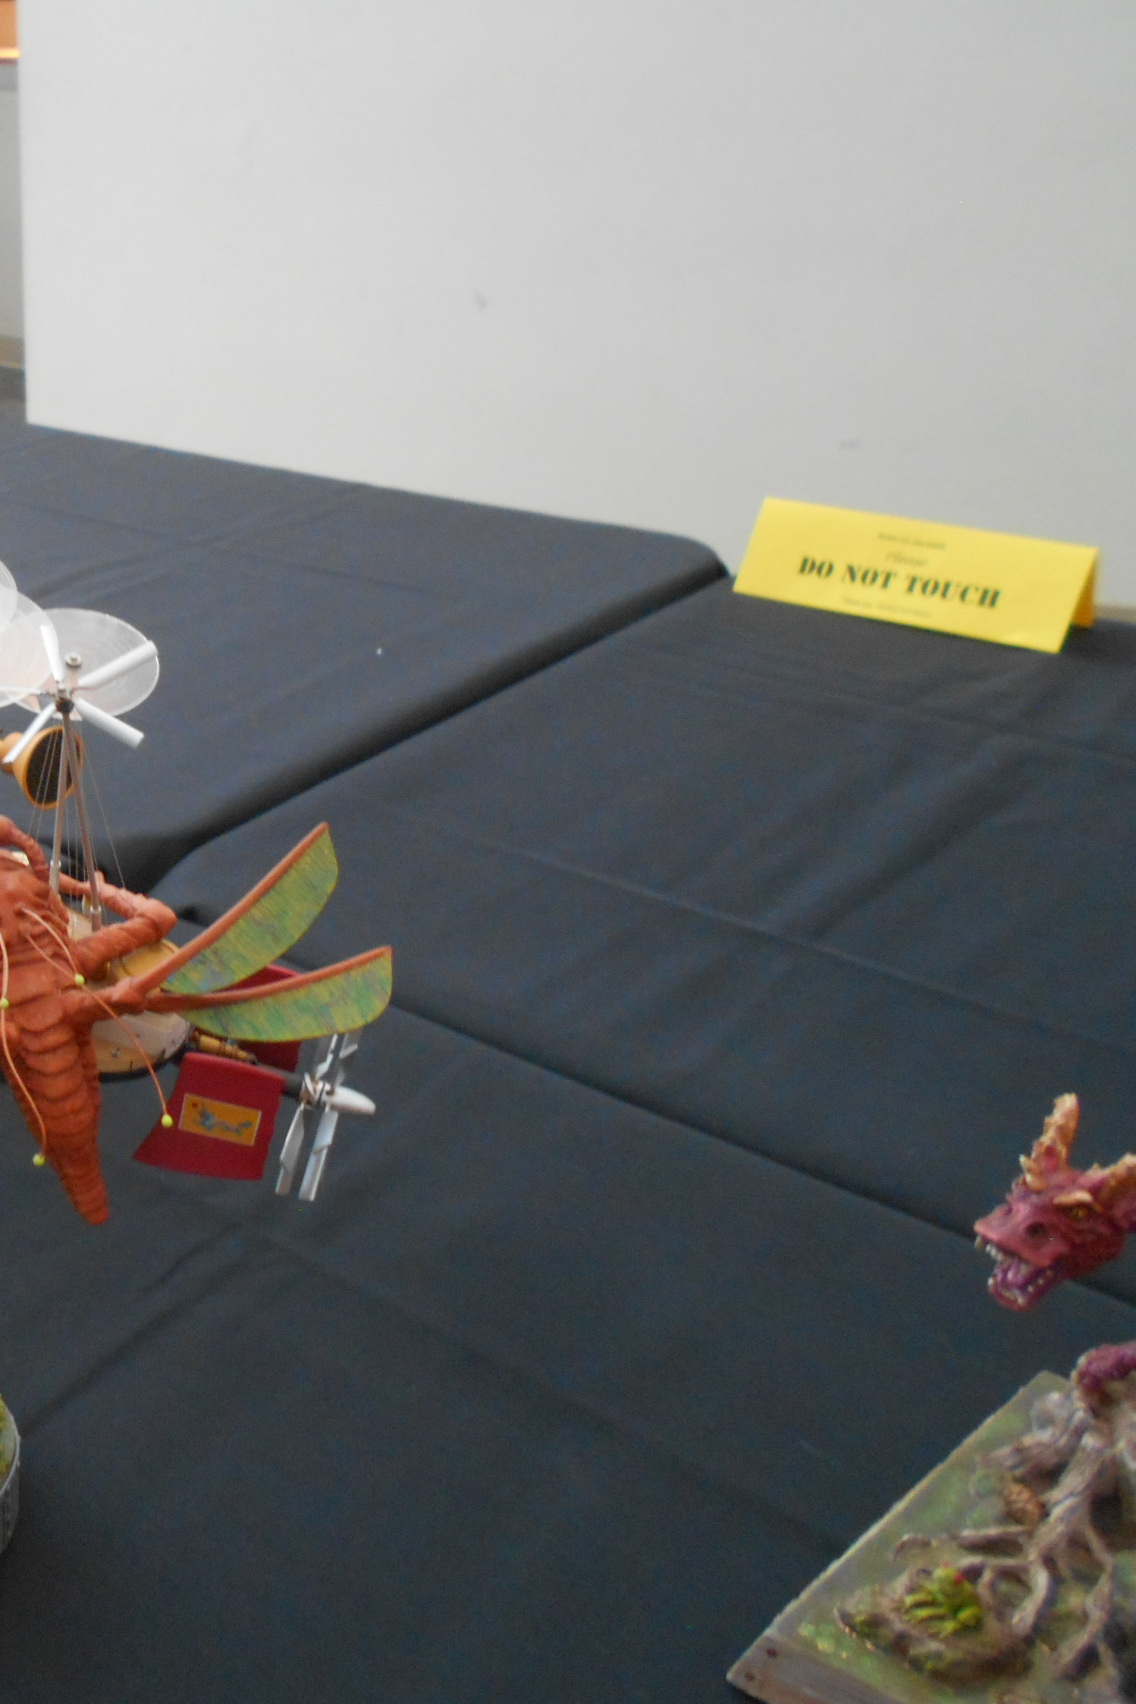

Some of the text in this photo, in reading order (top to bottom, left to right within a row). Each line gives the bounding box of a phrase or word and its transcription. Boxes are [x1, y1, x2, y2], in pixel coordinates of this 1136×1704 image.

[798, 556, 835, 578] DO
[842, 564, 898, 590] NOT
[906, 573, 1002, 609] TOUCH
